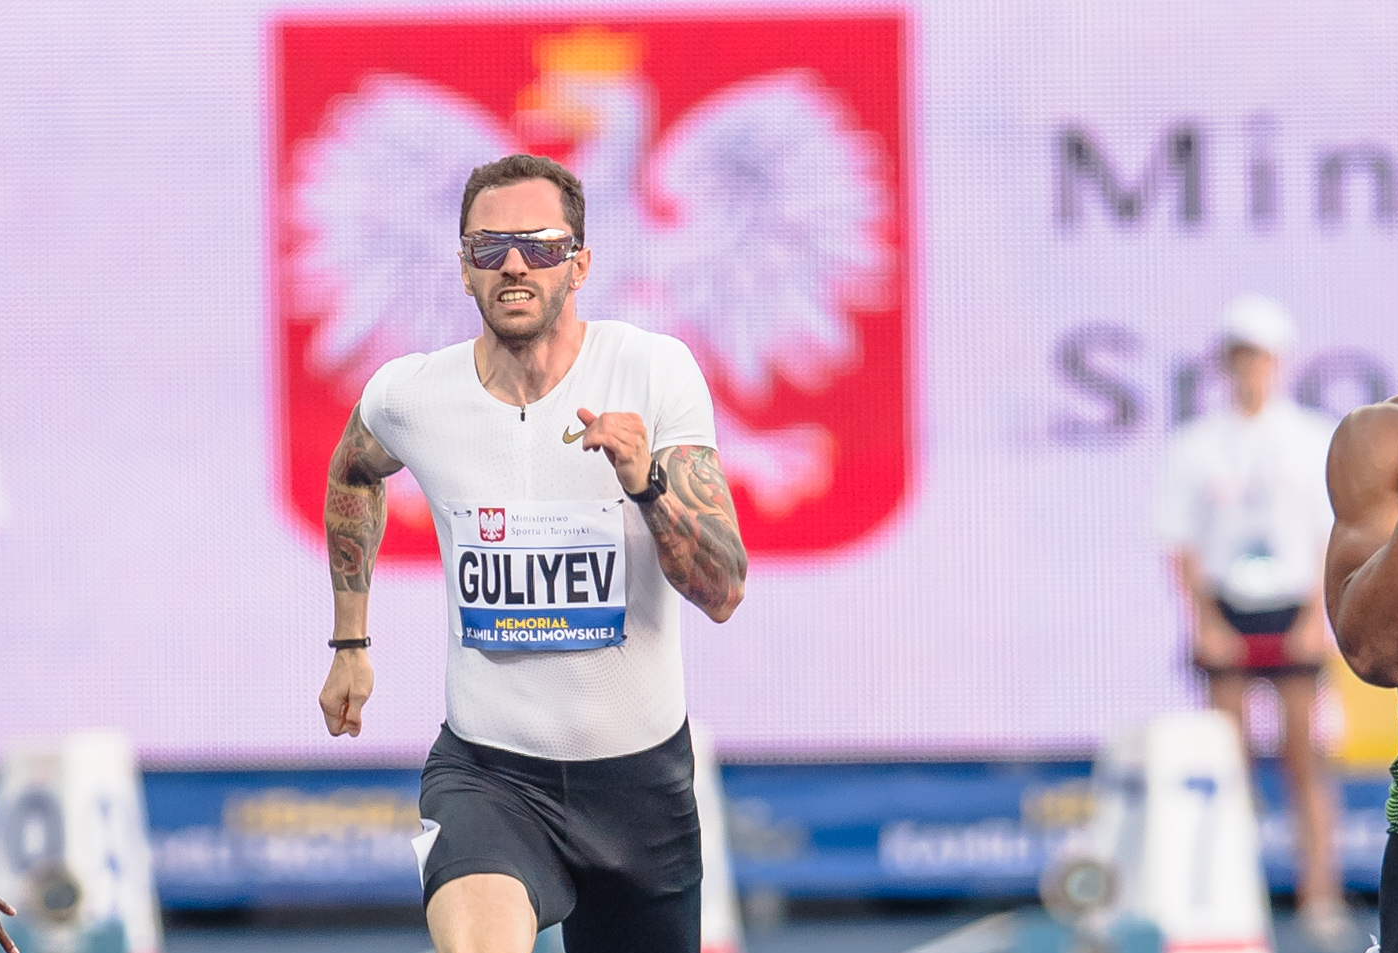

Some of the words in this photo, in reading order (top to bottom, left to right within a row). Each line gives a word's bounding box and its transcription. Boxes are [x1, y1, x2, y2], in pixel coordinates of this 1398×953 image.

[510, 514, 569, 523] Ministerstwo
[510, 527, 541, 537] Sportu
[550, 527, 590, 537] Turystyki
[458, 550, 617, 605] GULIYEV
[495, 617, 569, 629] MEMORIAŁ
[465, 627, 498, 642] KAMILI
[501, 627, 615, 642] SKOLIMOWSKIEJ
